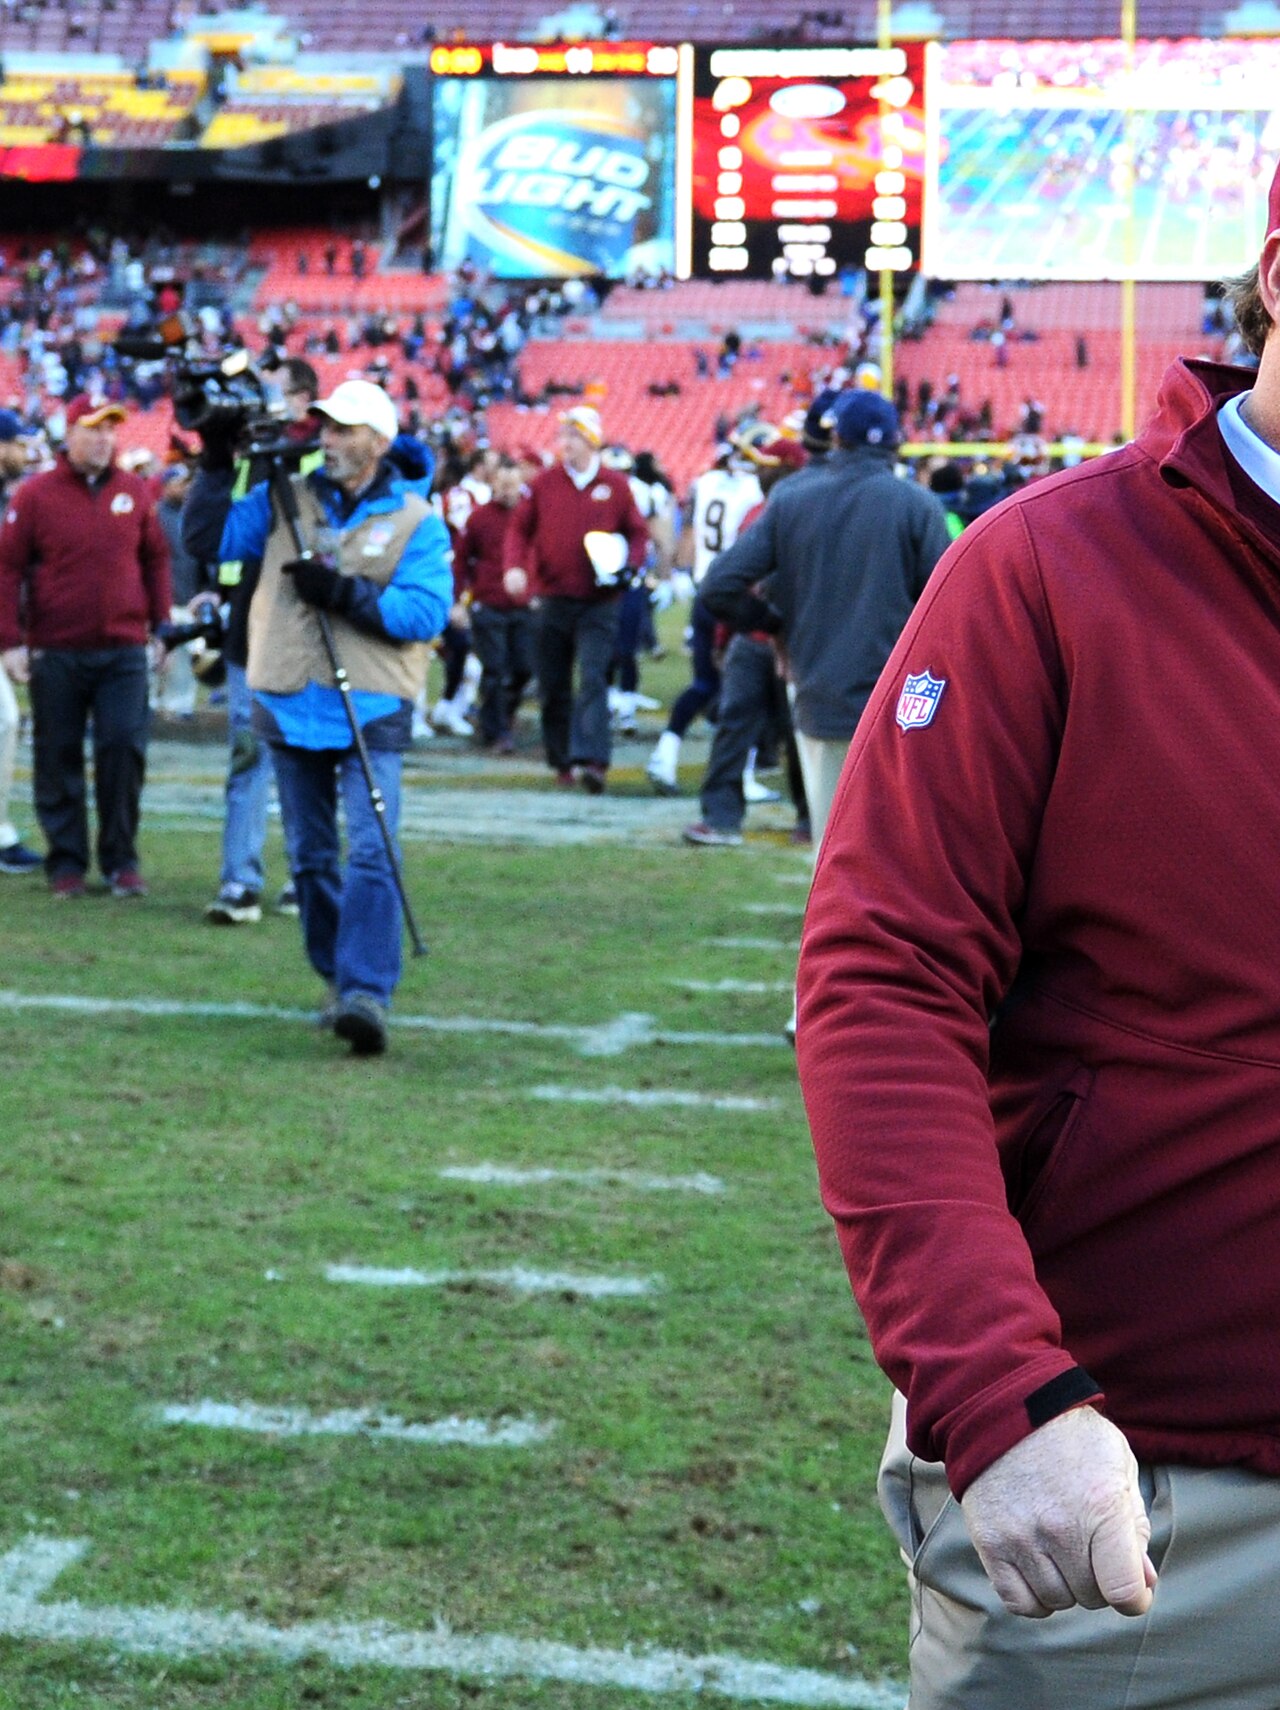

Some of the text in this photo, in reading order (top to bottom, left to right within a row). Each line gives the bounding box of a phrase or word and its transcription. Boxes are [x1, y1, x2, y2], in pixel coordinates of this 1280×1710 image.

[495, 135, 649, 189] BUD
[473, 167, 651, 223] LIGHT
[898, 695, 929, 721] NFL
